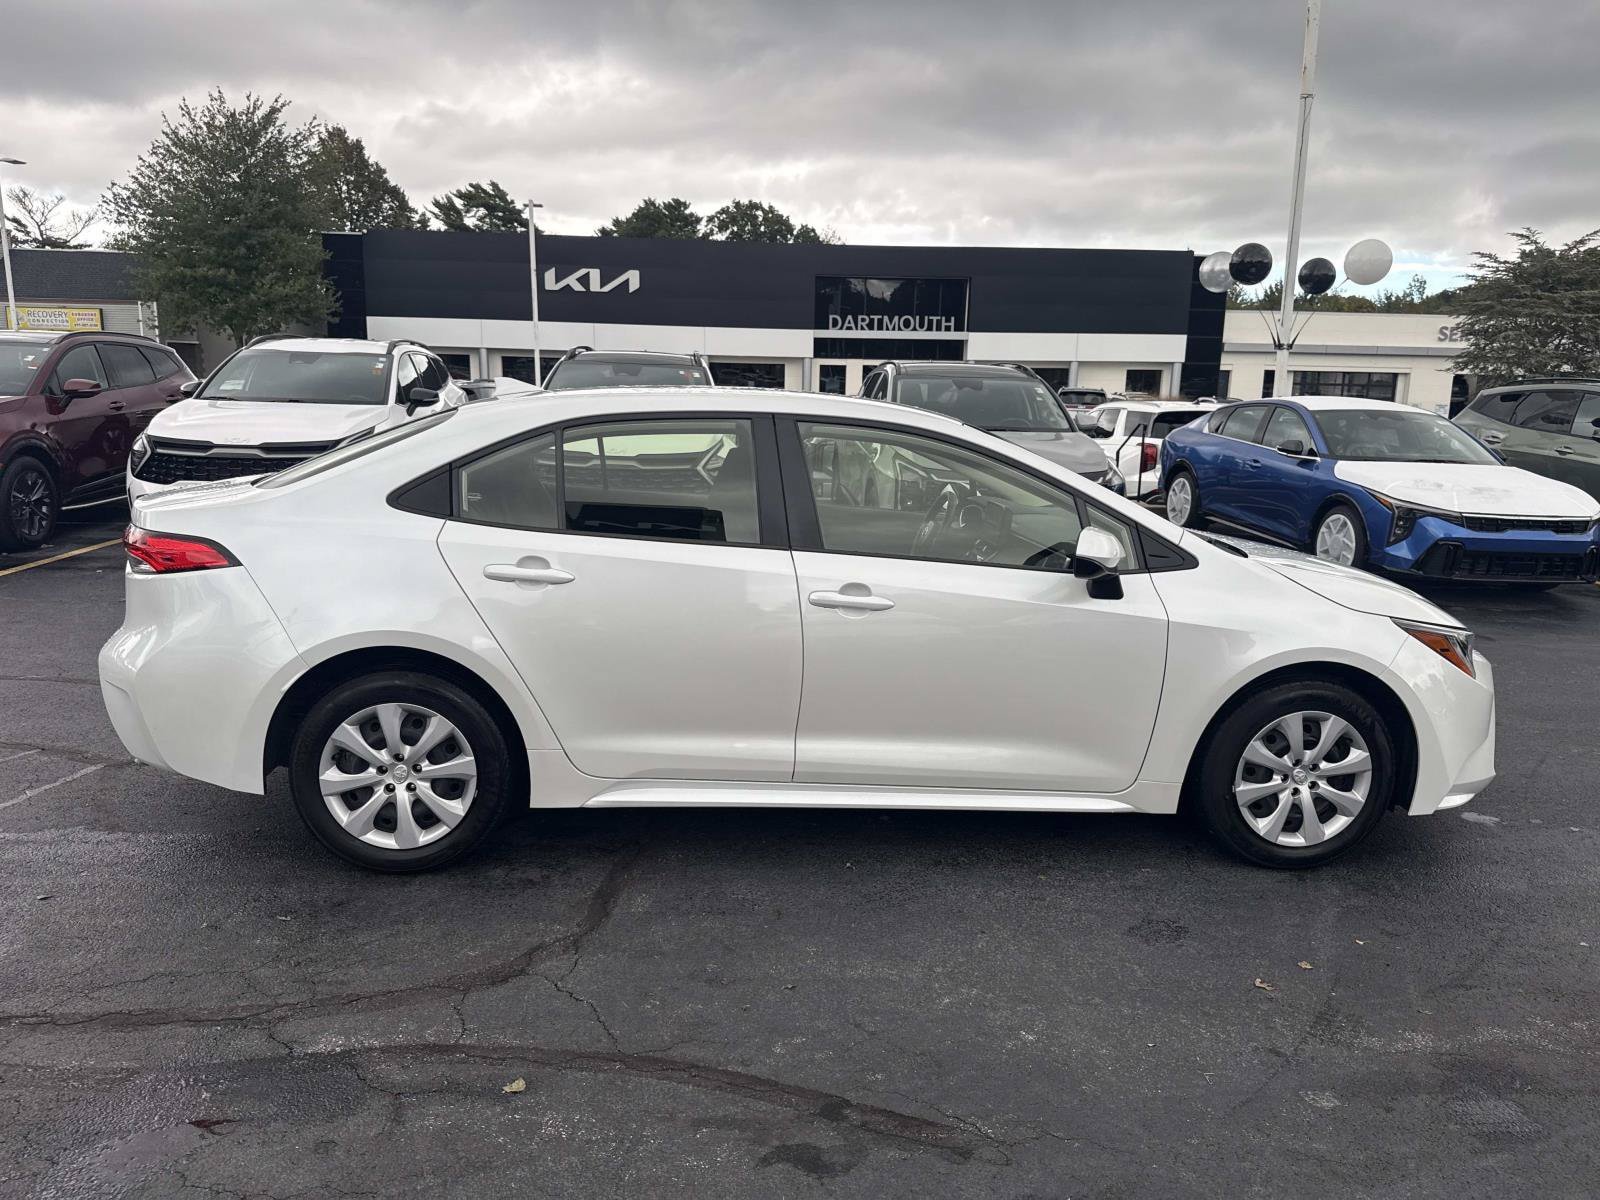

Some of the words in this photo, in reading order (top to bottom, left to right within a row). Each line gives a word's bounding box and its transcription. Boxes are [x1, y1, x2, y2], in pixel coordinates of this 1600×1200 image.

[544, 267, 640, 293] KIA
[27, 310, 68, 319] RECOVERY
[828, 314, 955, 332] DARTMOUTH
